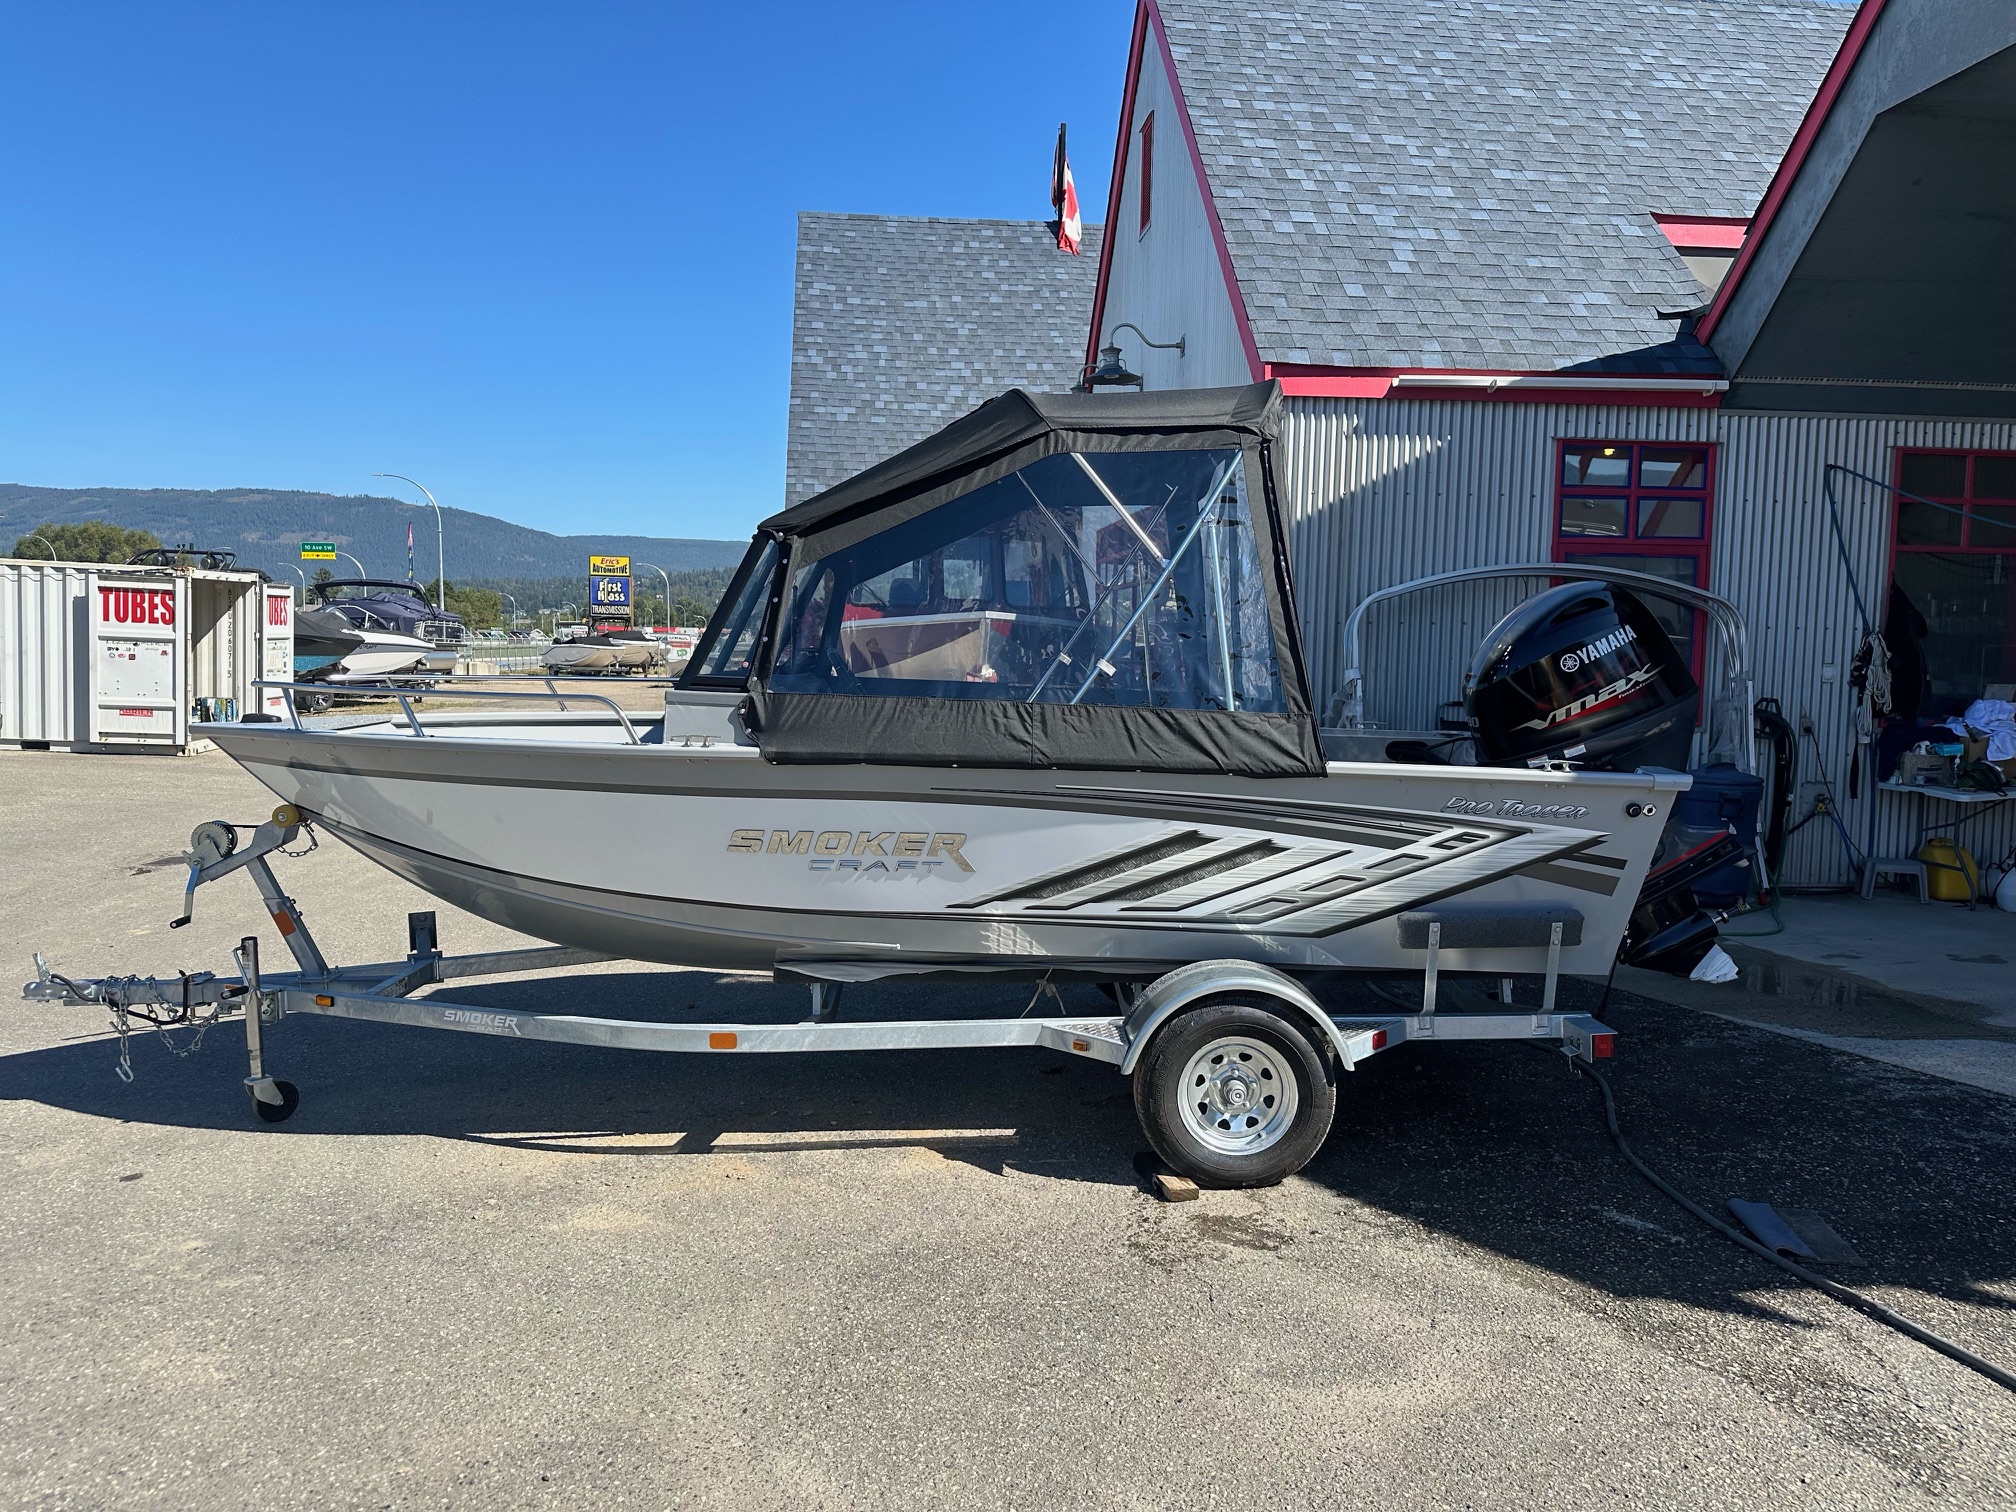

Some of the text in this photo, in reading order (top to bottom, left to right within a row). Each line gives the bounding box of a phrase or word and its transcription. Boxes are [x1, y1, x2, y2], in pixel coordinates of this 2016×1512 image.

[592, 563, 628, 574] AUTOMOTIVE
[600, 557, 620, 565] Eric's
[98, 587, 175, 626] TUBES
[267, 597, 288, 626] UBES
[592, 605, 630, 615] TRANSMISSION
[1576, 624, 1638, 665] YAMAHA
[1440, 796, 1590, 819] Pro Tracer
[726, 828, 977, 873] SMOKER
[808, 859, 944, 873] CRAFT
[443, 1010, 521, 1036] SMOKER
[467, 1024, 511, 1035] CRAFT
